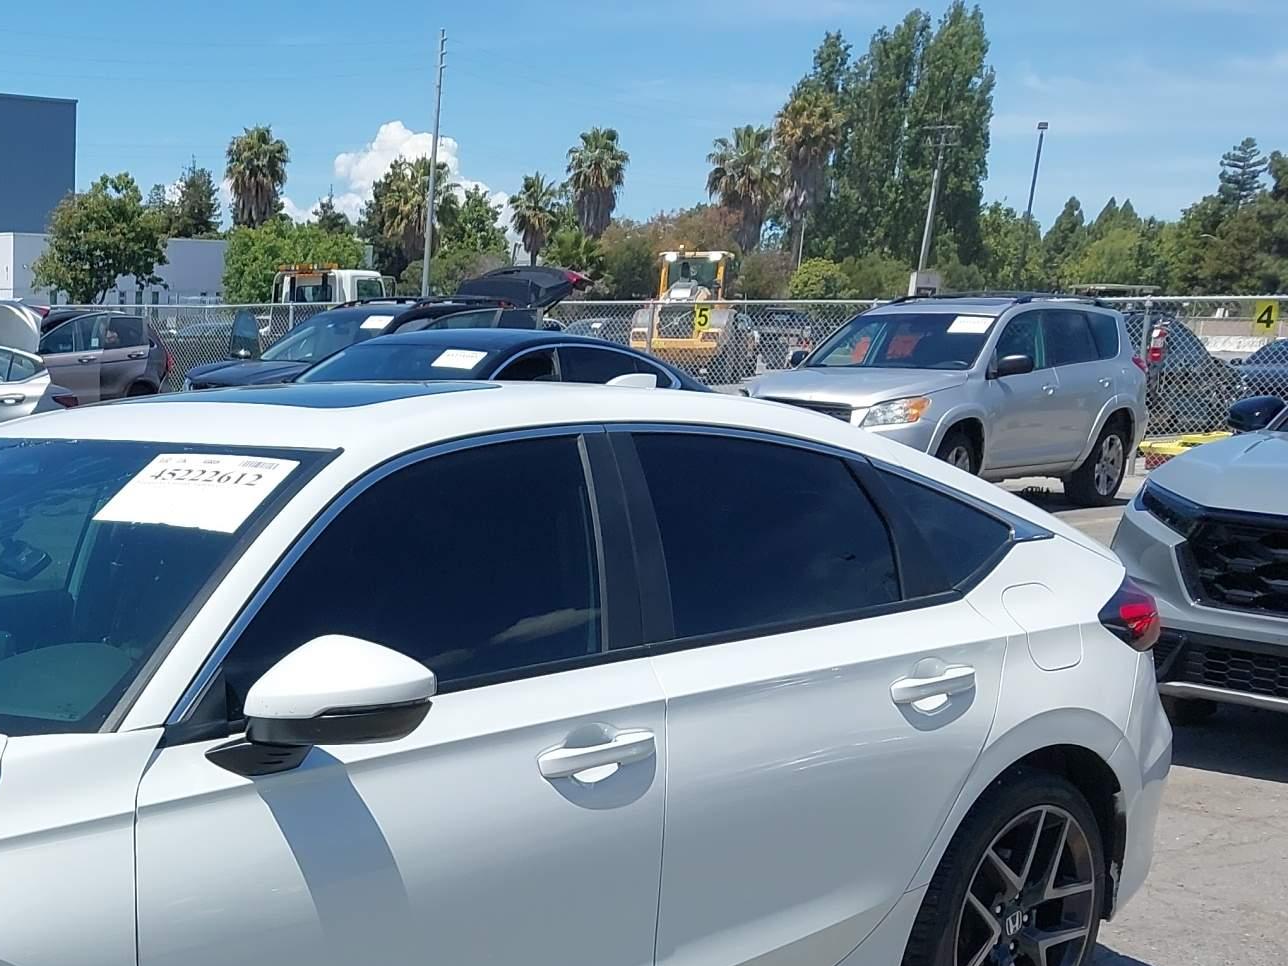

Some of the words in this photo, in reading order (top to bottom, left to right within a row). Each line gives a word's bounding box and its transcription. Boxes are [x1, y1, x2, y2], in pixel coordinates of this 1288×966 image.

[698, 307, 709, 326] 5
[1257, 304, 1274, 328] 4
[150, 468, 263, 486] 45222612
